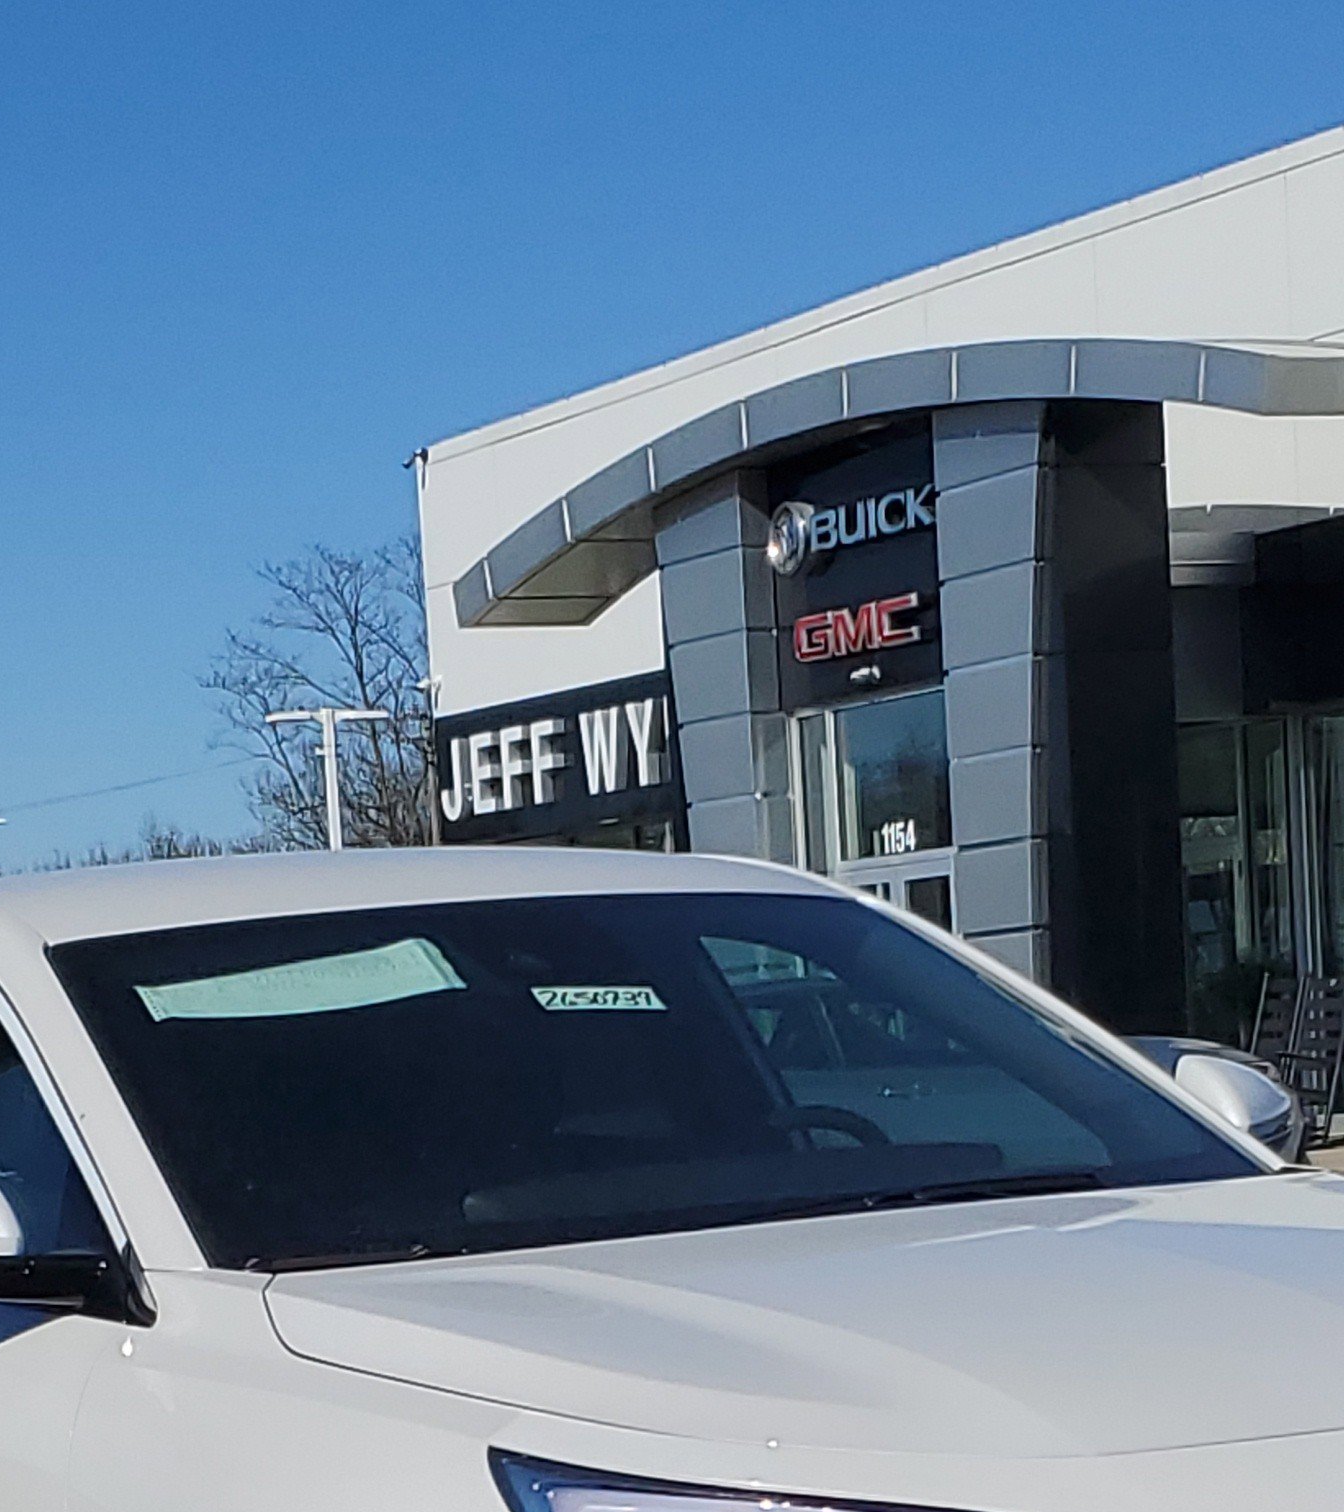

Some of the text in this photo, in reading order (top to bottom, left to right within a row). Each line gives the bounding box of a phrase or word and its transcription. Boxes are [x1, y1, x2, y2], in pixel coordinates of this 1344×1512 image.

[810, 484, 936, 553] BUICK
[793, 591, 922, 663] GMC
[440, 694, 671, 823] JEFF WY
[881, 818, 917, 855] 1154
